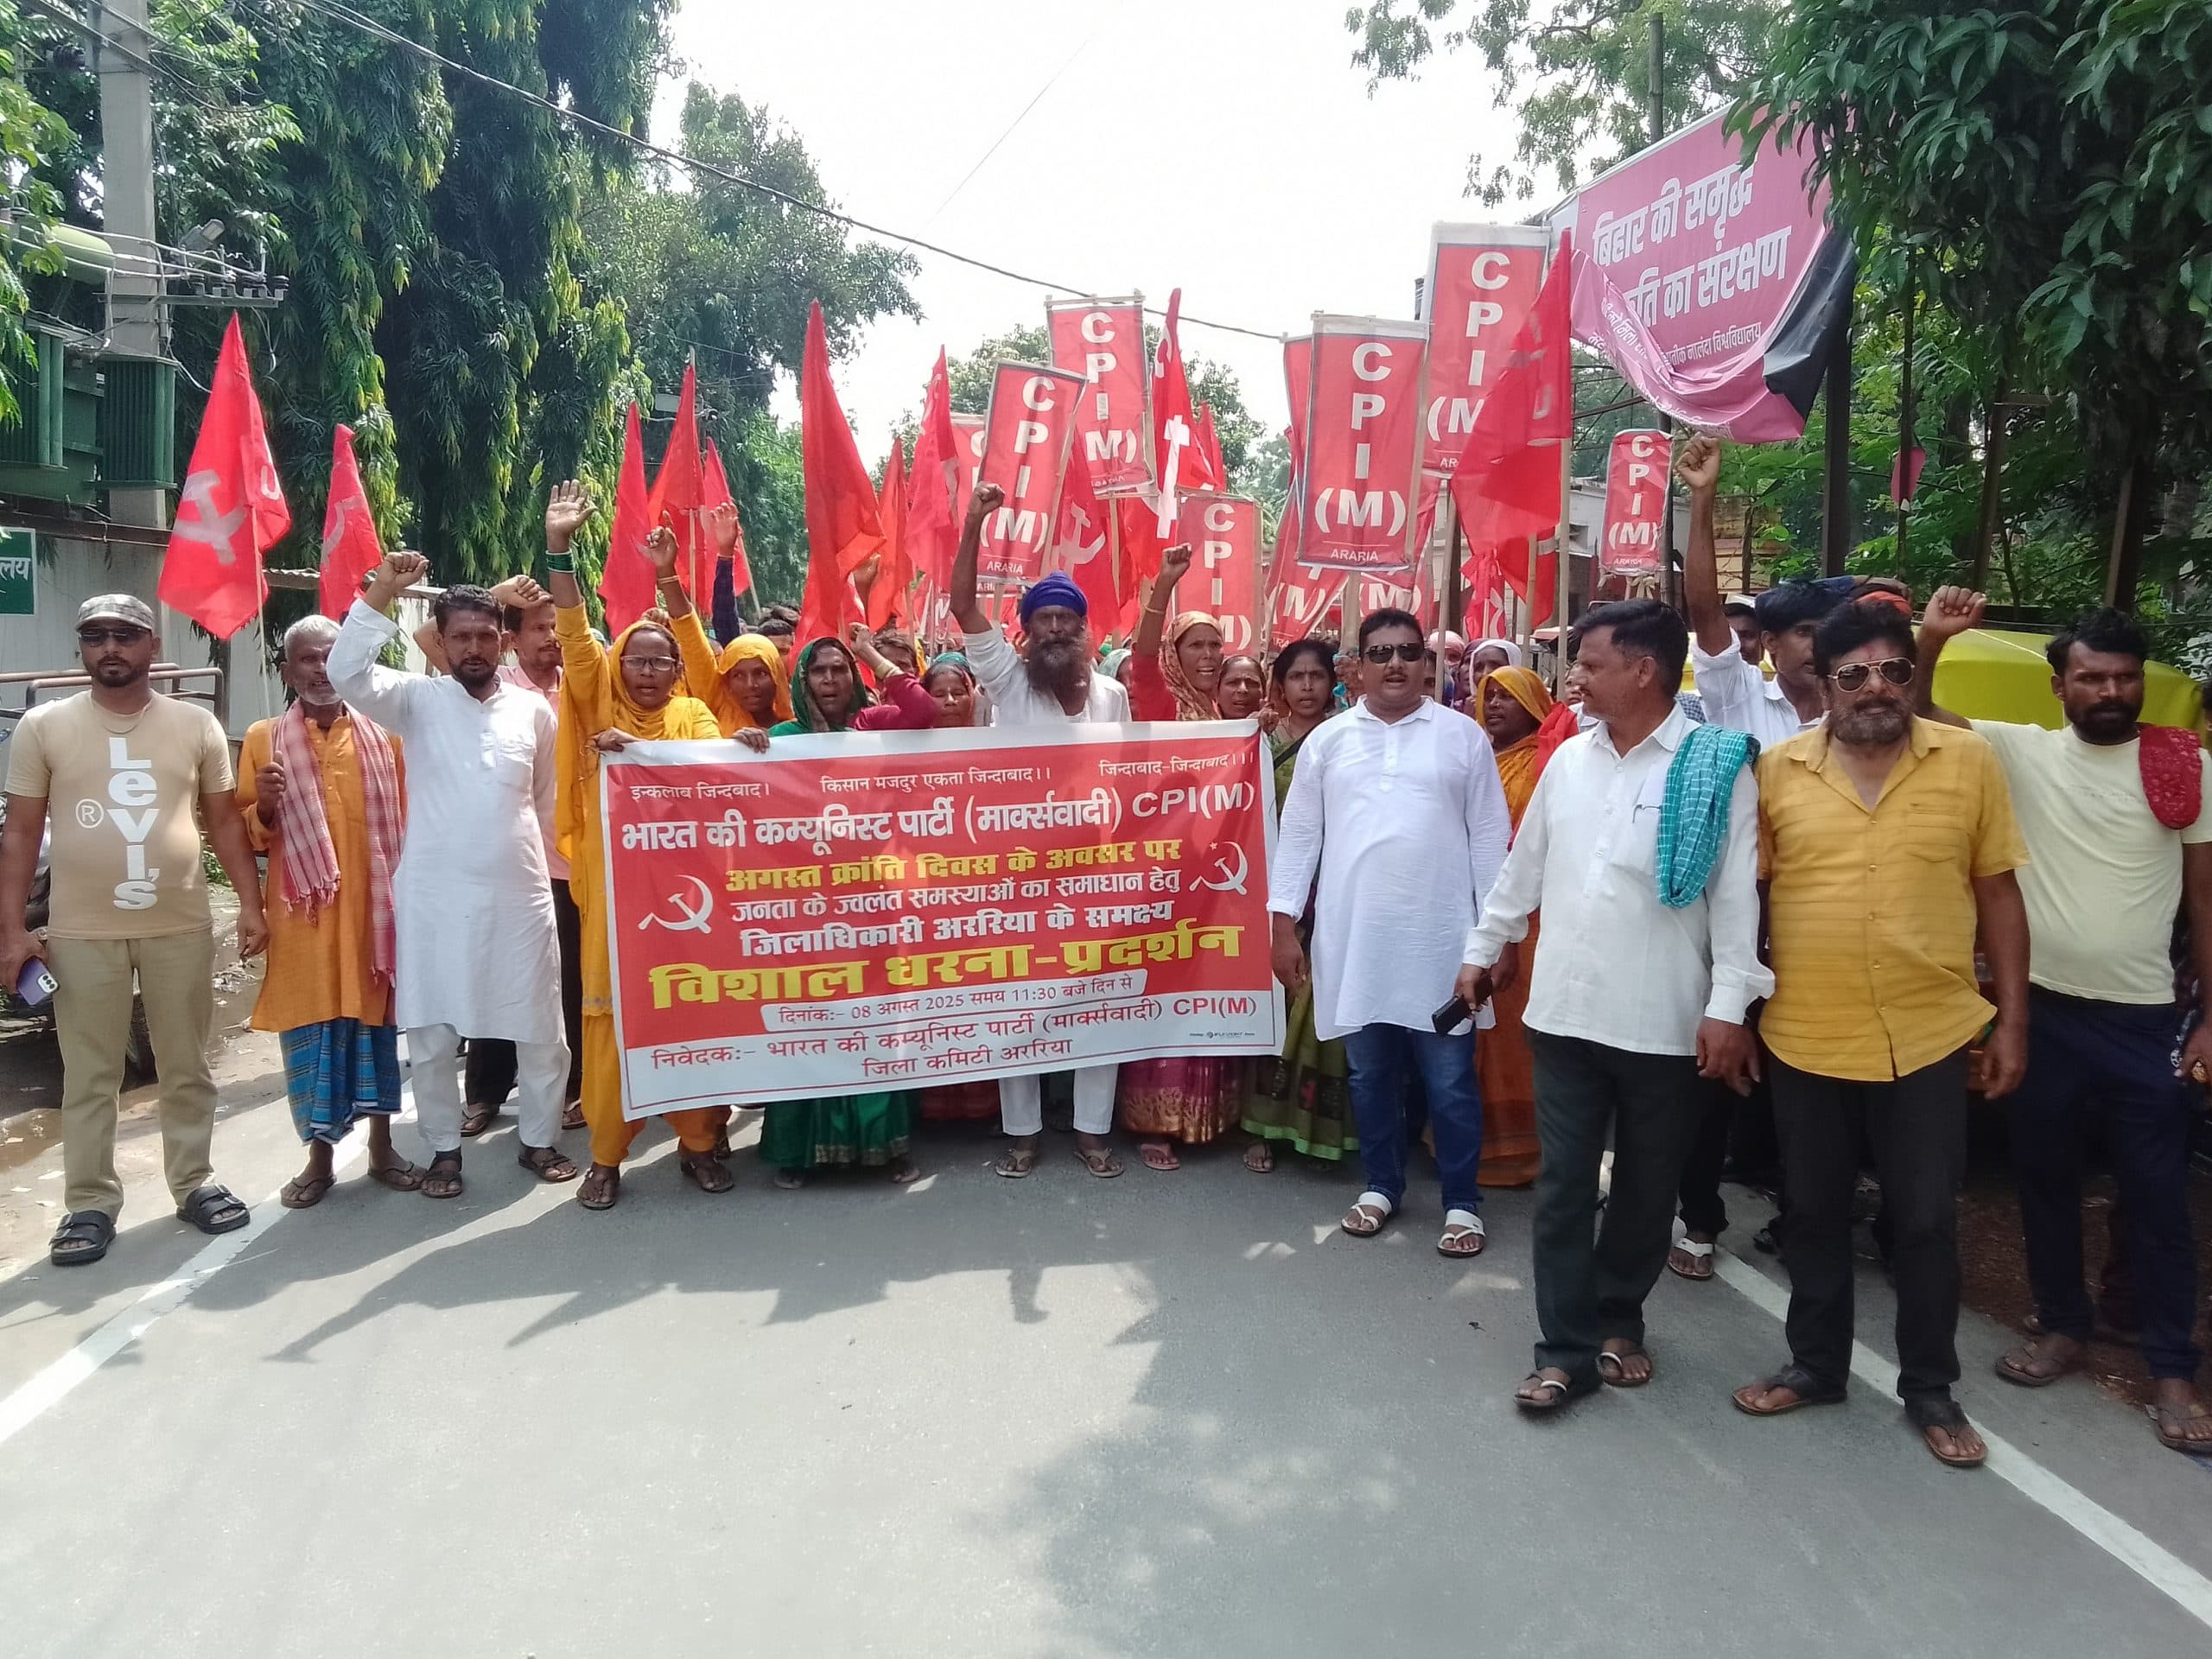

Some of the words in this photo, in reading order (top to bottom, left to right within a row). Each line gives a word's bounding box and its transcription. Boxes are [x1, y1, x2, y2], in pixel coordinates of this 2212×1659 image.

[1592, 206, 1649, 266] बिहार
[1651, 177, 1682, 244] की
[1663, 264, 1694, 319] का
[1698, 226, 1792, 308] संरक्षण
[986, 561, 1024, 575] ARARIA
[1331, 549, 1379, 561] ARARIA
[629, 785, 692, 803] इन्कलाब
[820, 775, 870, 792] किसान
[874, 774, 918, 792] मजदुर
[921, 772, 964, 791] एकता
[622, 821, 698, 850] भारत
[704, 809, 747, 848] की
[753, 803, 893, 855] कम्यूनिस्ट
[897, 796, 955, 837] पार्टी
[1132, 781, 1255, 819] CPI(M)
[726, 865, 823, 892] अगस्त
[830, 855, 908, 887] क्रांति
[916, 852, 1000, 879] दिवस
[1006, 846, 1038, 873] के
[1046, 842, 1136, 869] अवसर
[1143, 839, 1183, 861] पर
[730, 899, 798, 922] जनता
[802, 892, 828, 917] के
[833, 885, 904, 915] ज्वलंत
[909, 876, 1017, 909] समस्याओं
[1020, 879, 1051, 899] का
[1056, 870, 1144, 897] समाधान
[1148, 866, 1181, 893] हेतु
[740, 915, 925, 957] जिलाधिकारी
[933, 907, 1038, 942] अररिया
[1045, 902, 1076, 930] के
[648, 960, 870, 1009] विशाल
[851, 1005, 870, 1019] 08
[877, 998, 921, 1016] अगस्त
[925, 995, 964, 1011] 2025
[969, 990, 1005, 1006] समय
[1014, 988, 1057, 1002] 11:30
[1061, 979, 1088, 998] बजे
[1090, 977, 1116, 995] दिन
[1118, 972, 1134, 989] से
[767, 1039, 827, 1058] भारत
[835, 1031, 868, 1053] की
[875, 1020, 979, 1051] कम्यूनिस्ट
[985, 1012, 1035, 1036] पार्टी
[1173, 996, 1257, 1018] CPI(M)
[861, 1058, 918, 1077] जिला
[926, 1045, 992, 1071] कमिटी
[1001, 1038, 1073, 1061] अररिया
